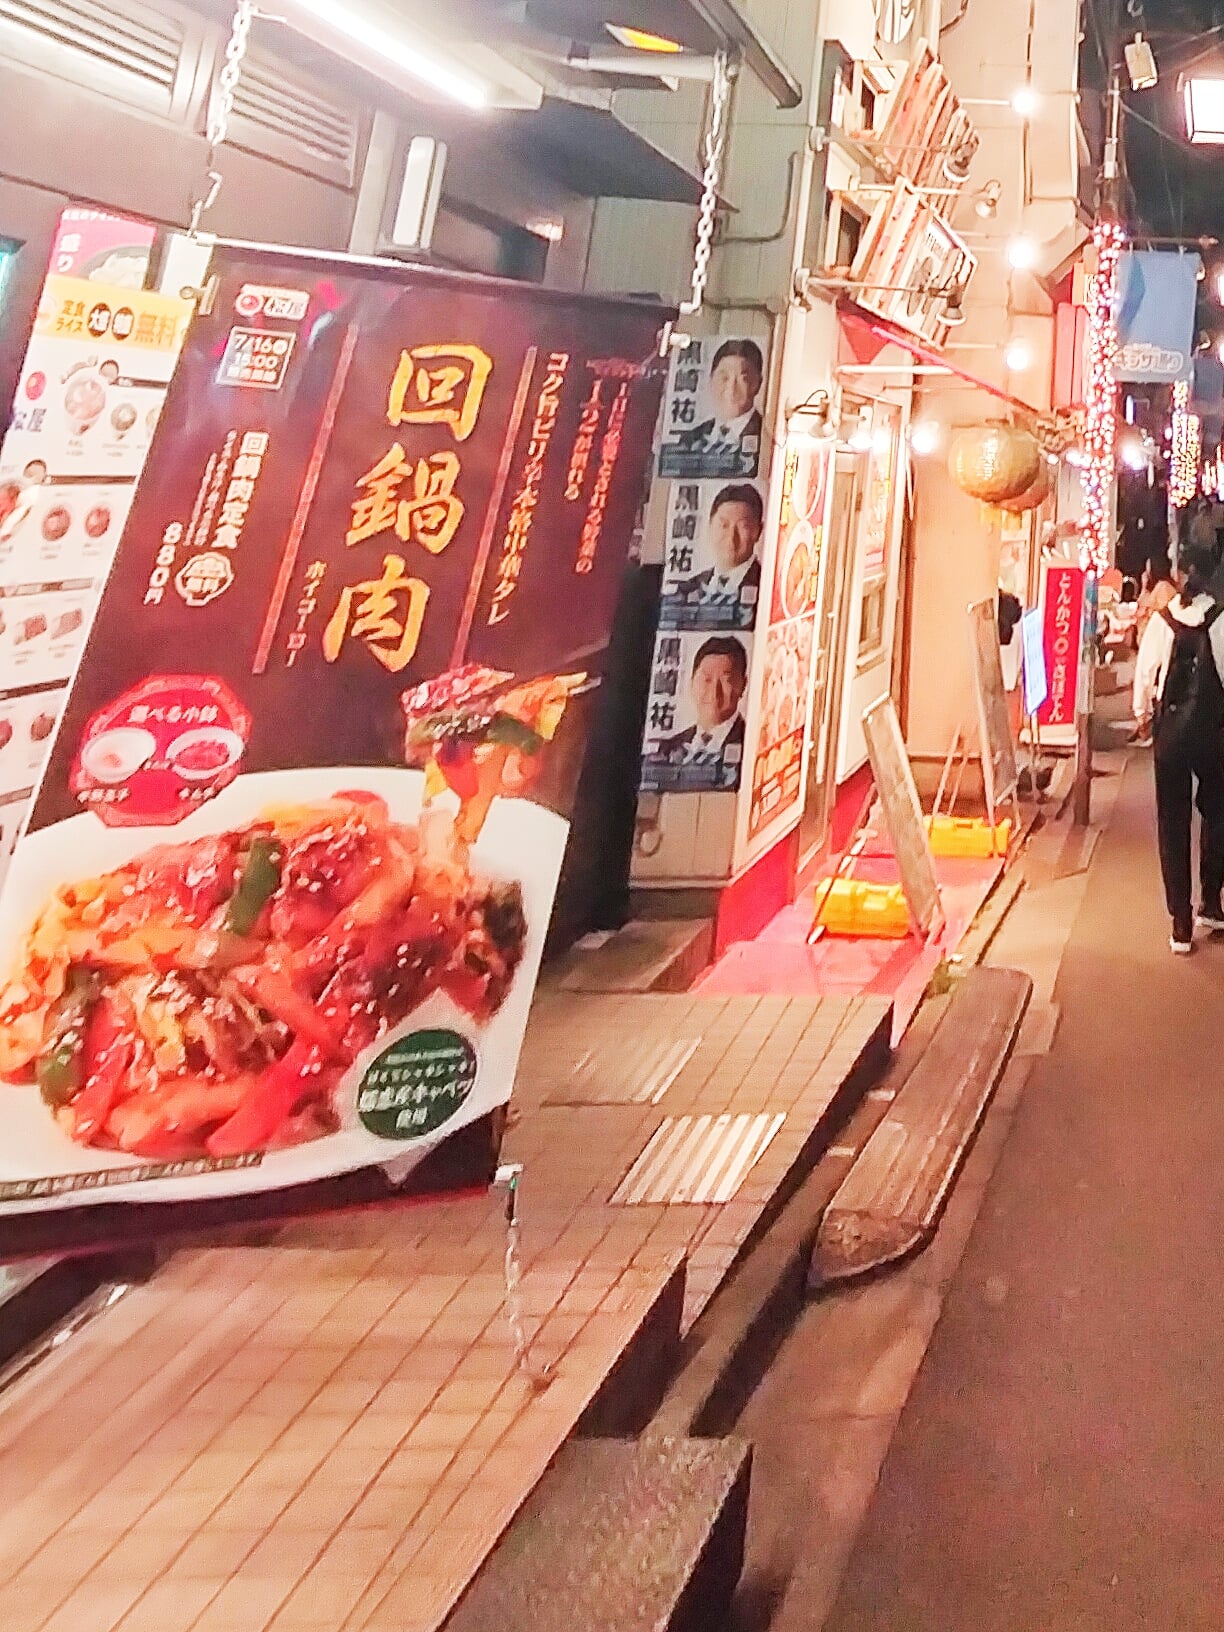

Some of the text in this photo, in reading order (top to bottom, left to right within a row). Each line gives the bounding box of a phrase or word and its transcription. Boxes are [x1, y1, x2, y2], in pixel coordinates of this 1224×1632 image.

[56, 317, 83, 333] ライス
[135, 312, 178, 347] 無料
[322, 344, 492, 672] 回鍋肉
[144, 522, 183, 605] 880円
[286, 561, 327, 667] ホイコーロー
[1056, 571, 1072, 636] とんかつ
